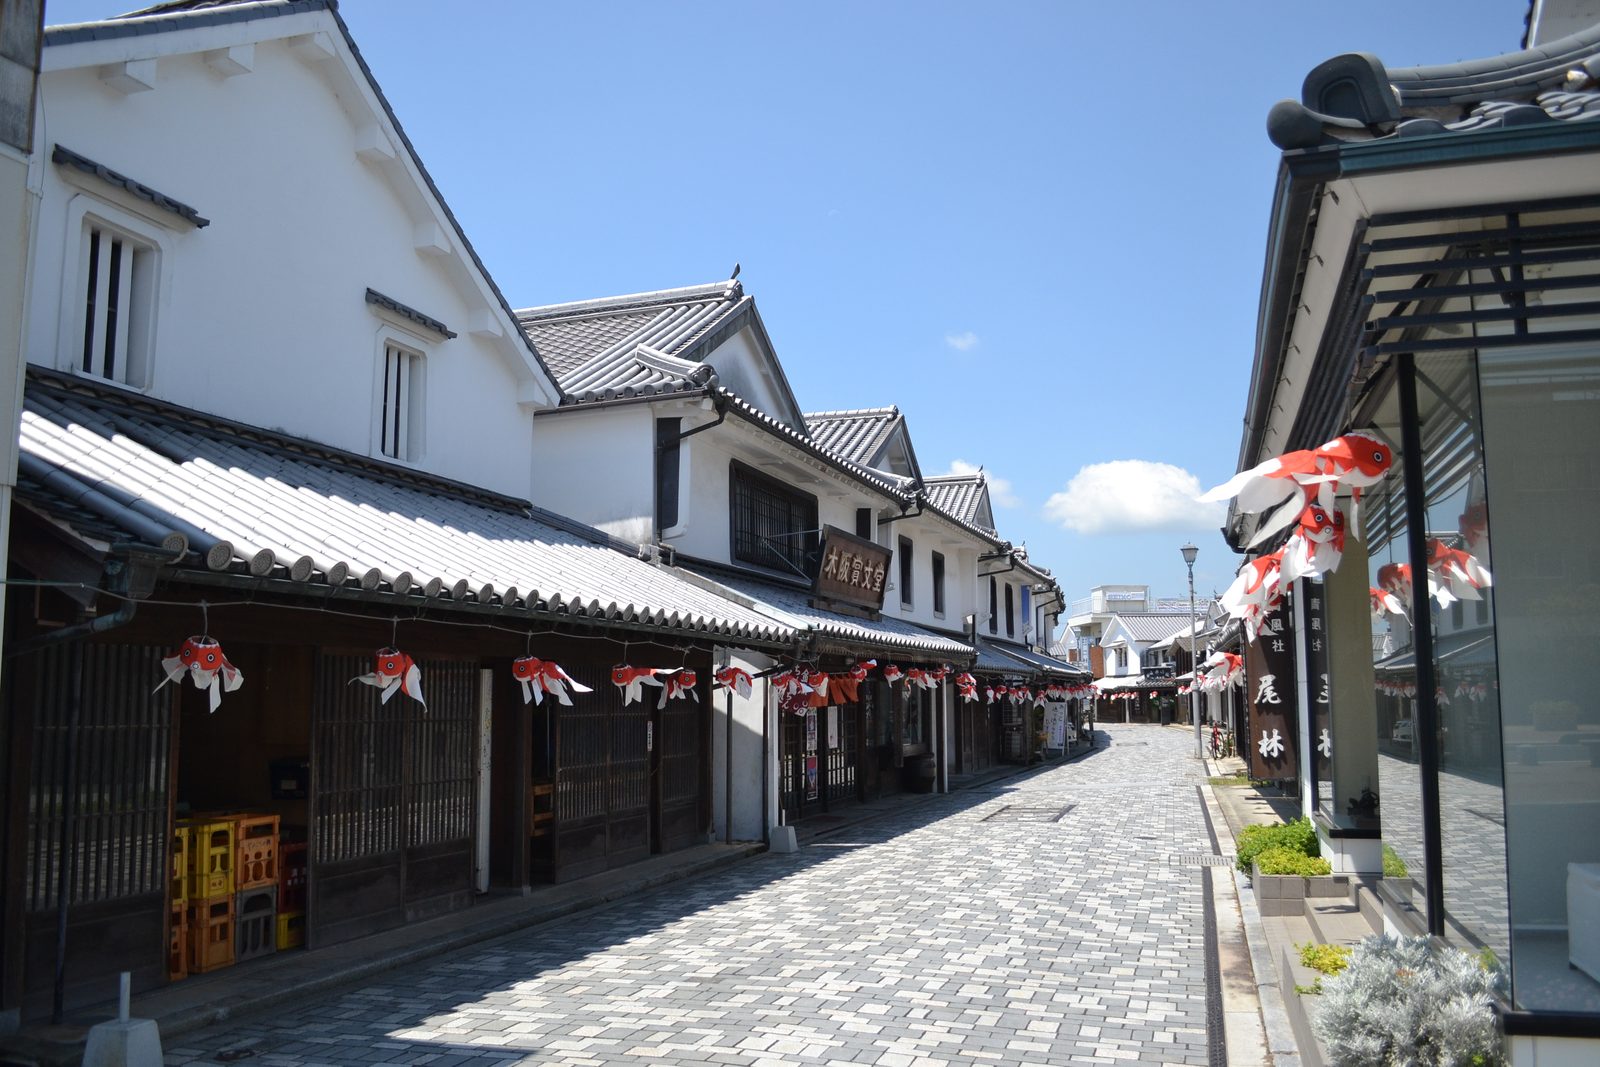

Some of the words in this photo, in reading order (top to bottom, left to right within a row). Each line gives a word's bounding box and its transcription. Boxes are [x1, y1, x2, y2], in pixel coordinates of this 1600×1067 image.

[824, 545, 885, 593] 木阪賞文堂
[1253, 674, 1285, 758] 尾林
